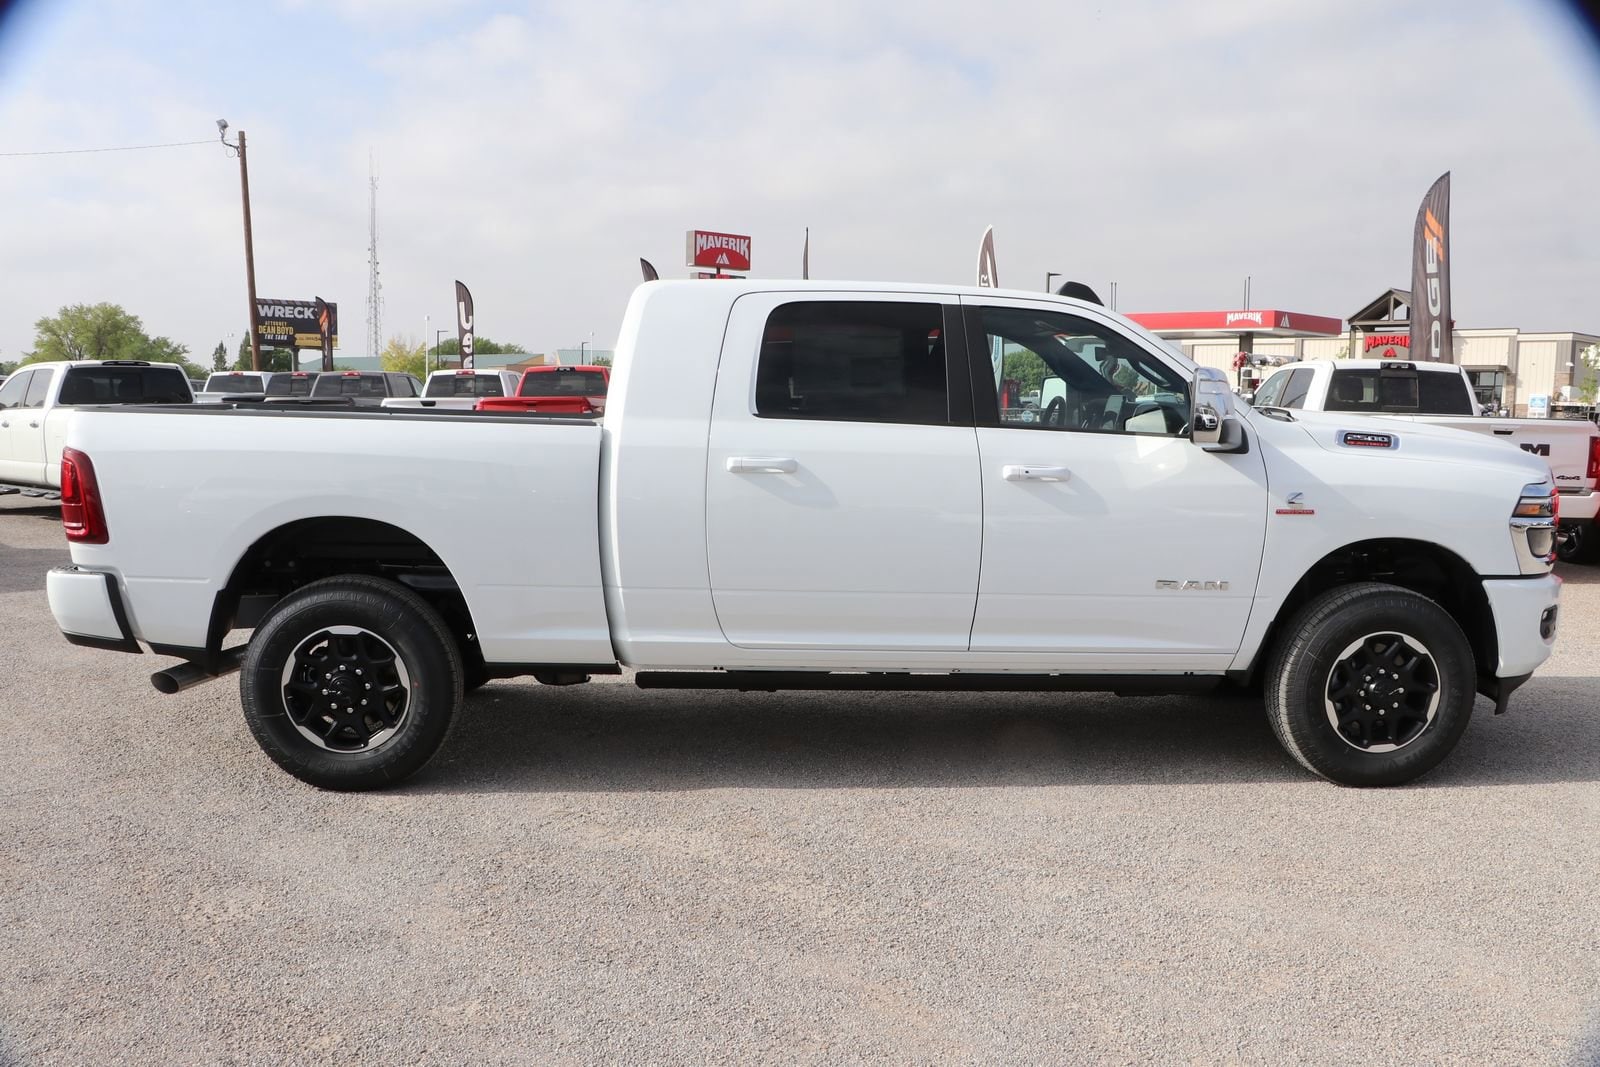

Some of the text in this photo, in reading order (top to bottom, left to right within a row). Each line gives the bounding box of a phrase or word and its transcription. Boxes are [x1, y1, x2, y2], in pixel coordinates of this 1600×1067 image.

[696, 233, 749, 261] MAVERIK
[1425, 237, 1440, 358] DGE
[1226, 311, 1262, 326] MAVERIK
[258, 325, 294, 335] DEAN BOYD
[1155, 579, 1230, 591] RAM
